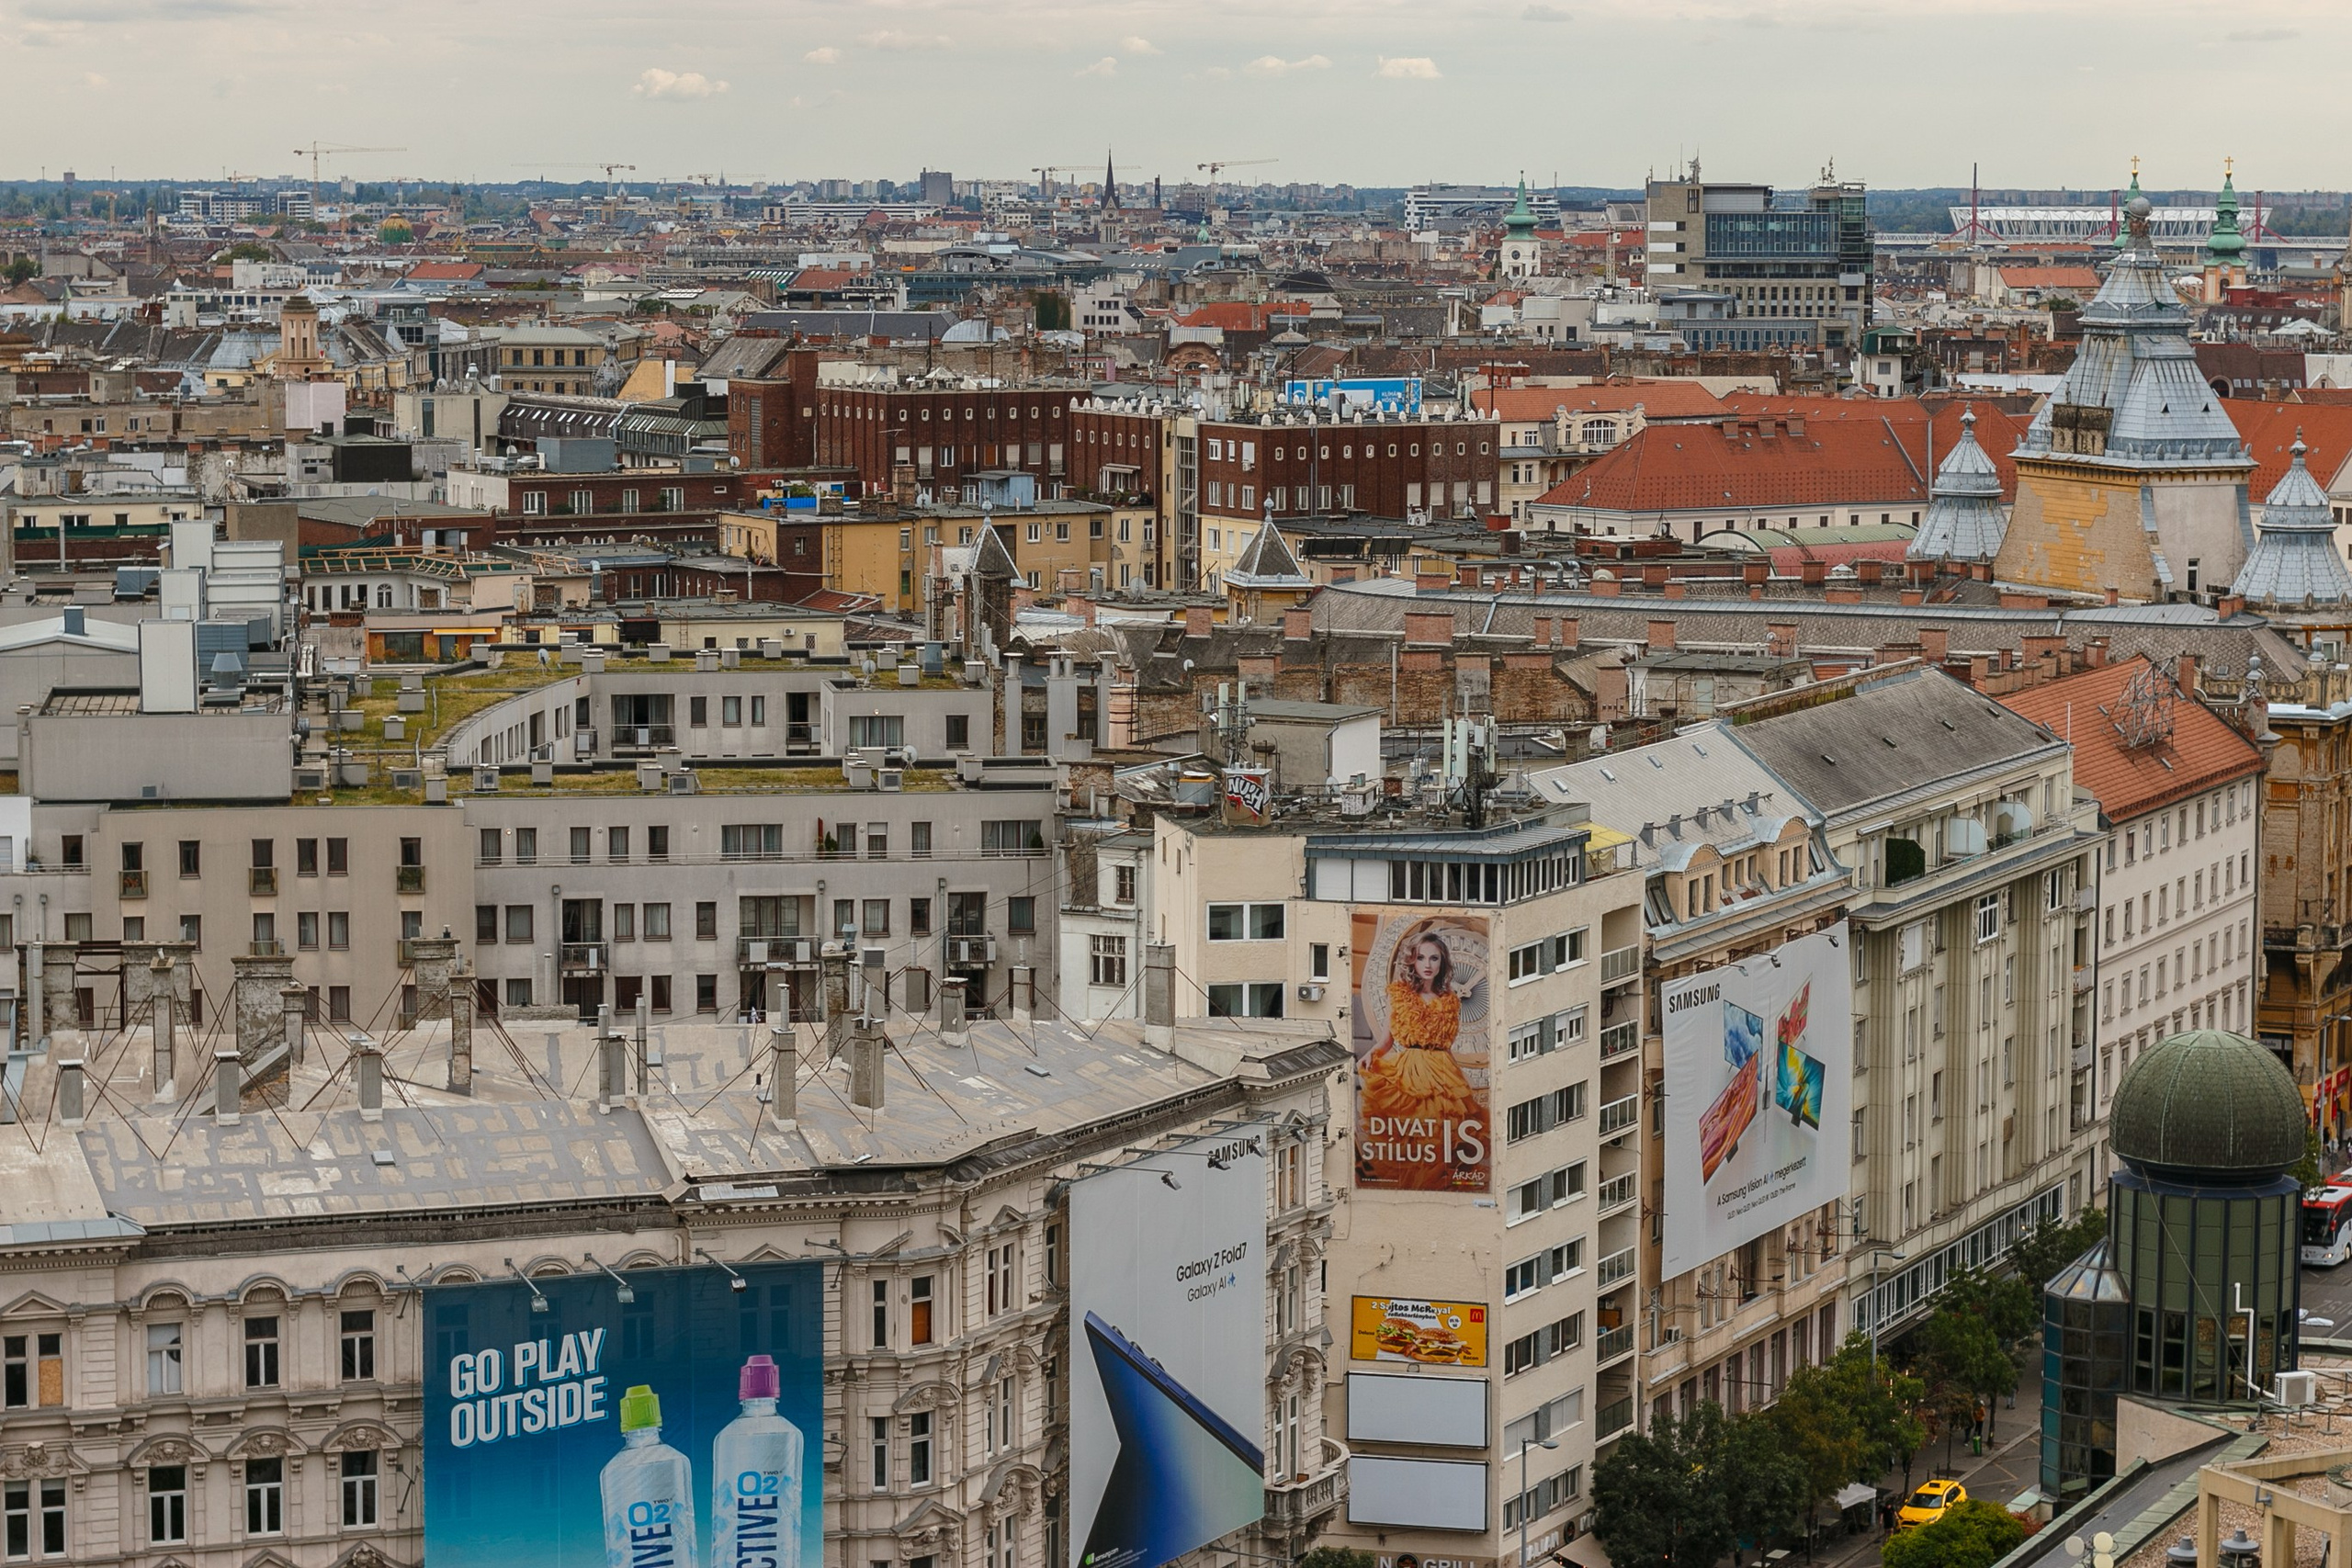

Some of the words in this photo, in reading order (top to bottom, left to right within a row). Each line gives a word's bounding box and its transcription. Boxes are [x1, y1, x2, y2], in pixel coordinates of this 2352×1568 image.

[1668, 983, 1720, 1013] SAMSUNG
[1370, 1117, 1437, 1138] DIVAT
[1362, 1137, 1437, 1164] STÍLUS
[1443, 1119, 1485, 1165] IS
[1452, 1169, 1486, 1180] ÁRKÁD
[1716, 1195, 1722, 1207] A
[1722, 1185, 1747, 1205] Samsung
[1747, 1178, 1763, 1193] Vision
[1176, 1260, 1213, 1282] Galaxy
[1214, 1251, 1220, 1269] Z
[1221, 1242, 1247, 1266] Fold7
[1187, 1281, 1217, 1303] Galaxy
[1218, 1275, 1227, 1291] AI
[450, 1348, 503, 1399] GO
[514, 1328, 605, 1387] PLAY
[450, 1376, 606, 1448] OUTSIDE
[738, 1471, 779, 1496] O2
[628, 1501, 671, 1527] O2
